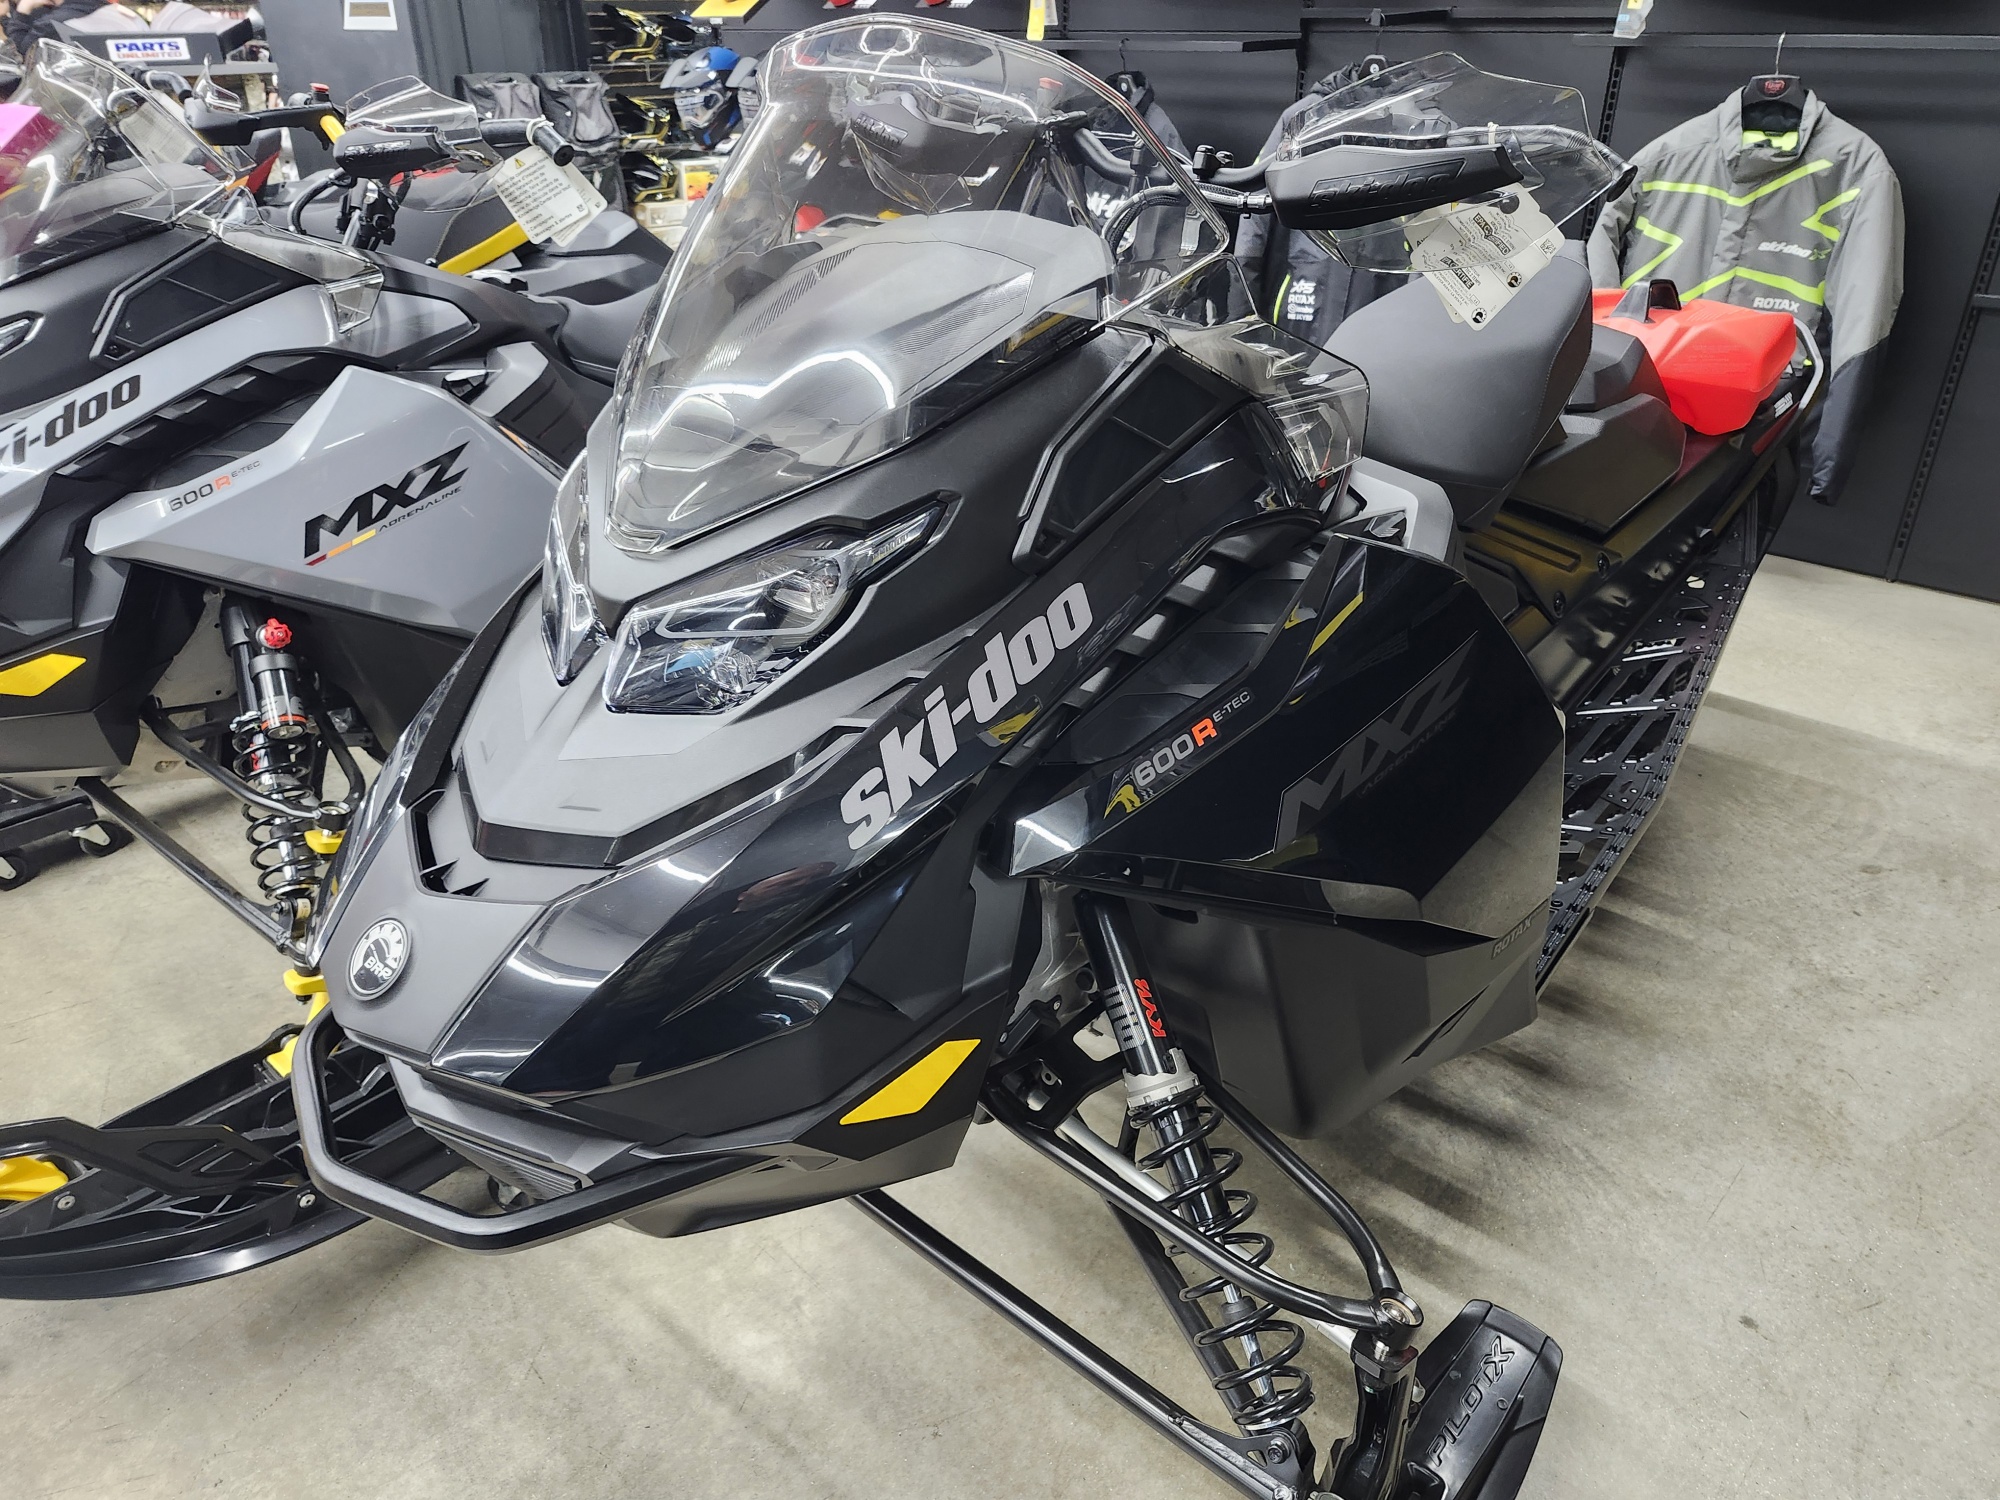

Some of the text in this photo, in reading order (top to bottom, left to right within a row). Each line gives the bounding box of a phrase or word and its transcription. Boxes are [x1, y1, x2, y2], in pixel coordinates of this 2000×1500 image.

[114, 41, 181, 52] PARTS
[116, 51, 182, 59] UNLIMITED
[1757, 241, 1812, 258] ski-doo
[1753, 296, 1800, 312] ROTAX
[0, 374, 141, 465] i-doo
[231, 460, 261, 478] E-TEC
[304, 440, 471, 558] MXZ
[378, 486, 462, 532] ADRENALINE
[840, 582, 1093, 850] ski-doo
[1212, 691, 1250, 722] E-TEC
[1274, 636, 1476, 853] MXZ
[1493, 915, 1532, 958] ROTAX
[363, 956, 393, 980] BRP
[1134, 979, 1167, 1037] KYB
